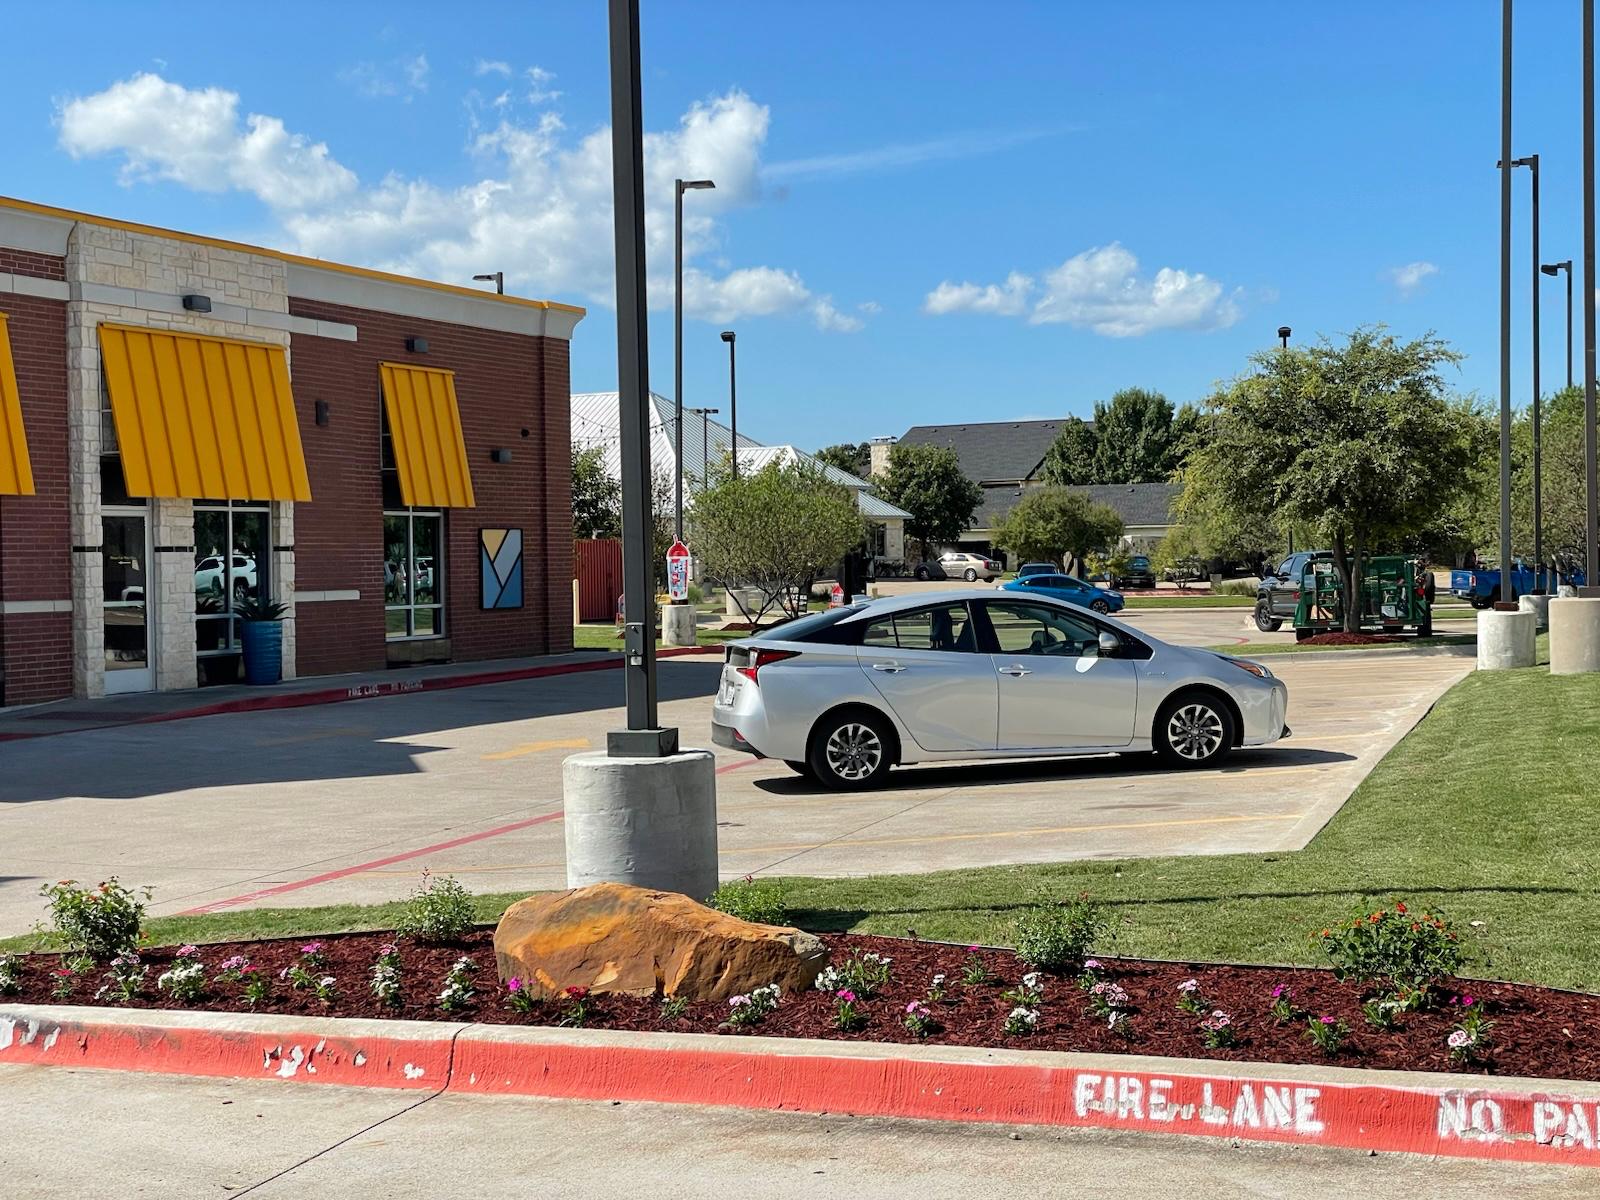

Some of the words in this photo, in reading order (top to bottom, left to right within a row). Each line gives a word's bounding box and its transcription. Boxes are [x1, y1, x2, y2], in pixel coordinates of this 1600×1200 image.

[1074, 1074, 1174, 1121] FIRE
[1201, 1082, 1324, 1134] LANE
[1438, 1091, 1503, 1142] NO
[1533, 1099, 1600, 1150] PA
